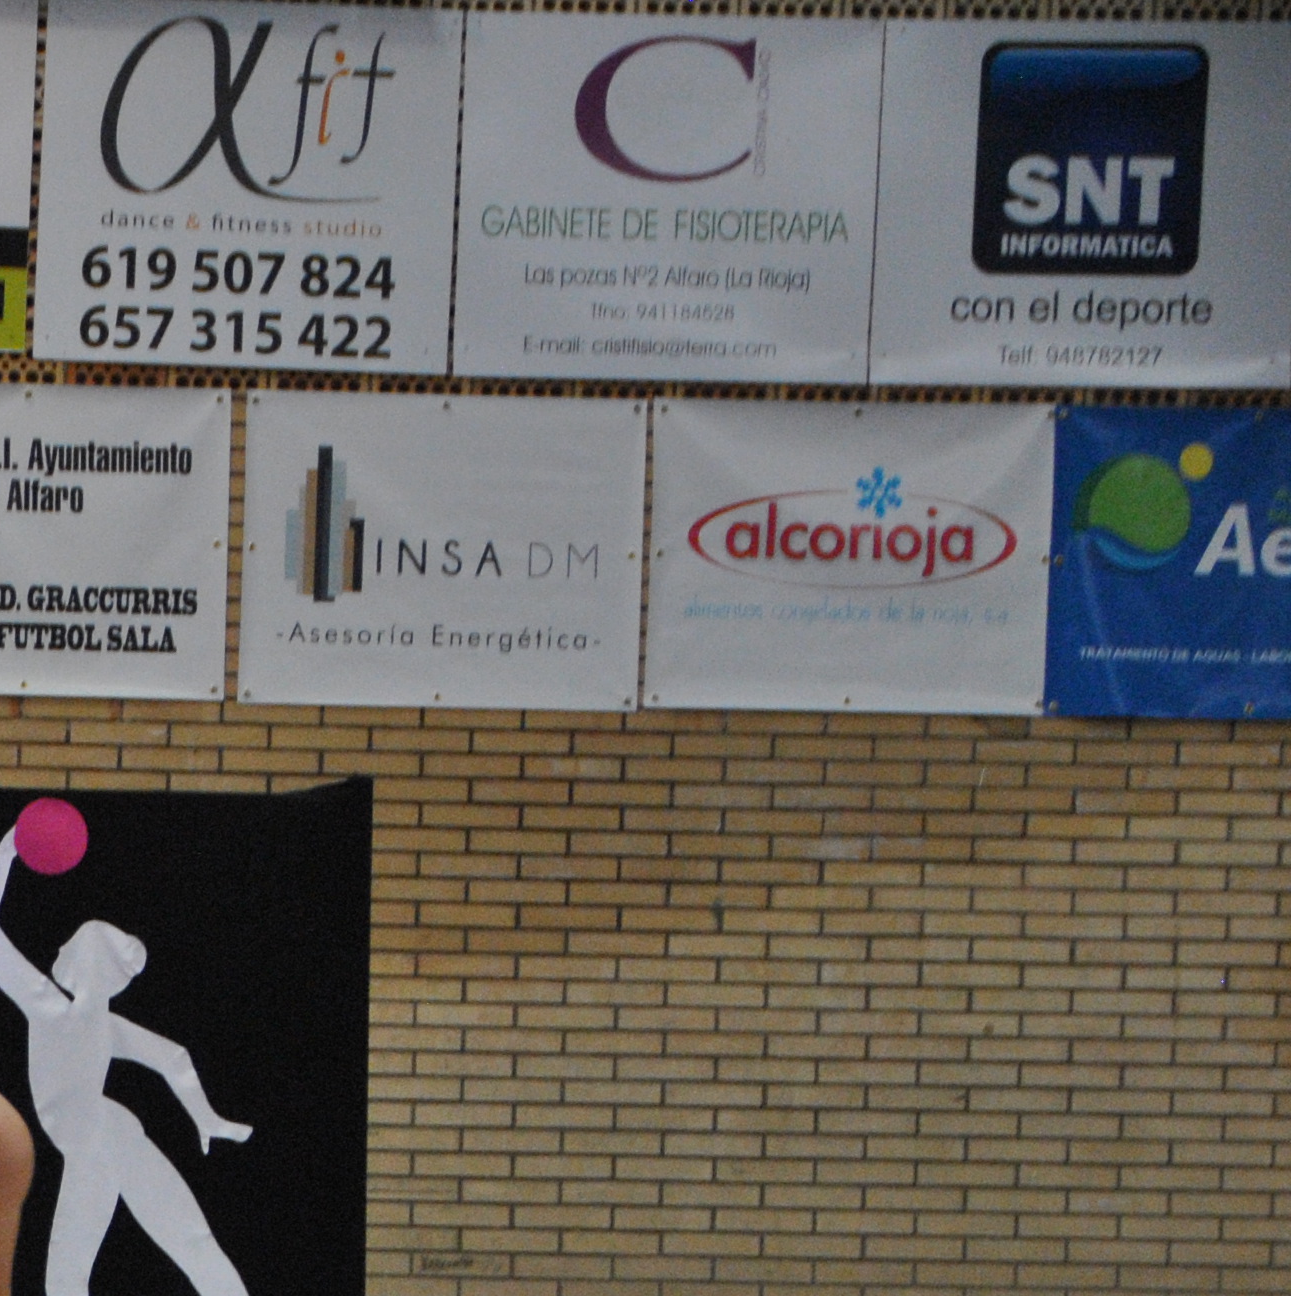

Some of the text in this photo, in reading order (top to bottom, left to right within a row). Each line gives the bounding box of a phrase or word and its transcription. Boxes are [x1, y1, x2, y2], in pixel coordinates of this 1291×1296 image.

[1002, 153, 1176, 226] SNT
[100, 209, 384, 238] dance & fitness studio
[481, 204, 849, 243] GABINETE DE FISIOTERAPIA
[1000, 233, 1173, 258] INFORMATICA
[81, 244, 396, 300] 619 507 824
[524, 264, 554, 285] Las
[560, 269, 617, 290] pozas
[664, 266, 720, 288] Alfaro
[725, 266, 752, 292] (La
[758, 267, 812, 293] Rioja)
[951, 289, 1213, 331] con el deporte
[79, 304, 392, 359] 657 315 422
[27, 438, 193, 477] Ayuntamiento
[7, 478, 84, 513] Alfaro
[376, 538, 599, 580] INSA DM
[725, 501, 975, 578] alcorioja
[27, 583, 198, 616] GRACCURRIS
[107, 624, 177, 653] SALA
